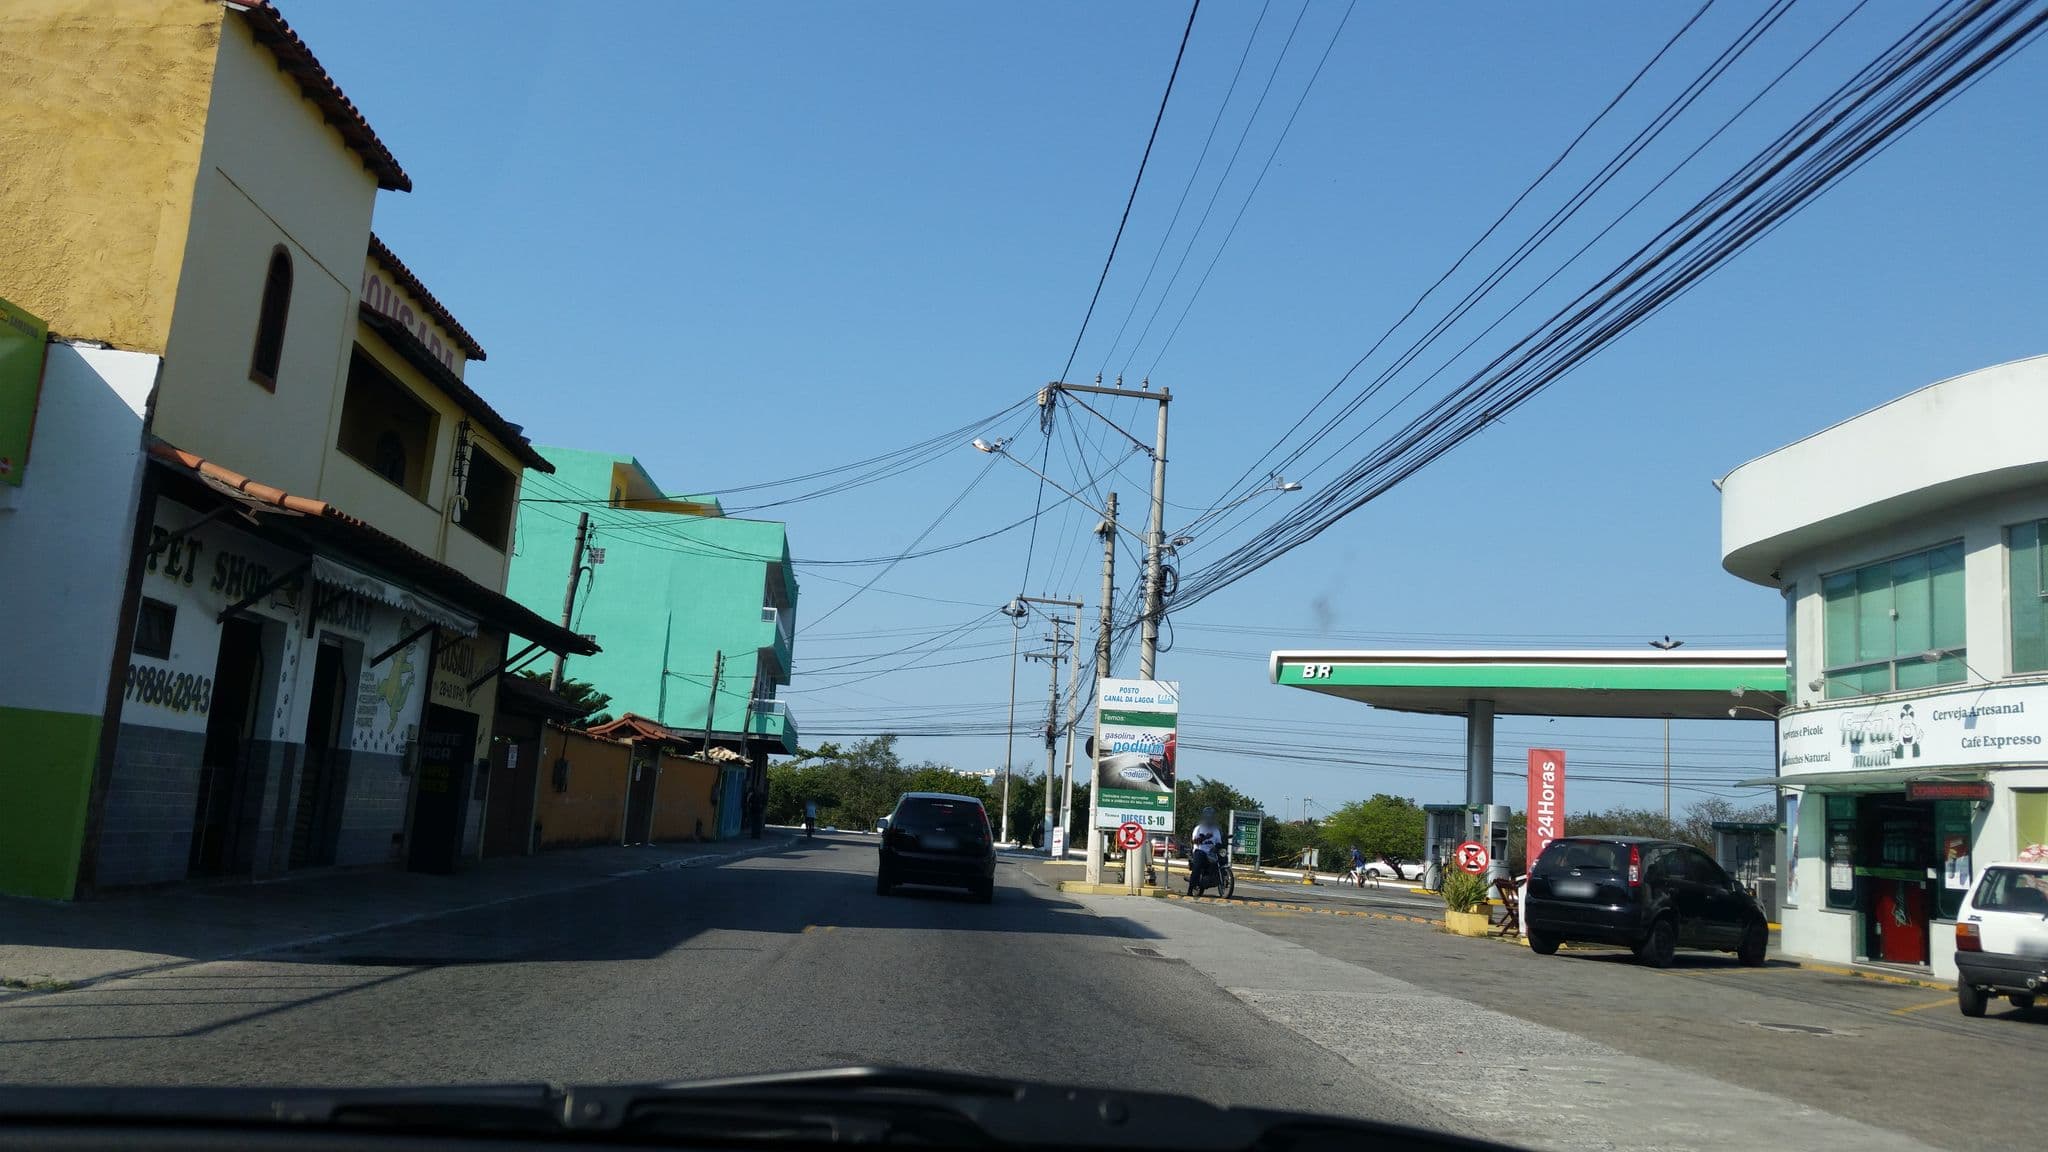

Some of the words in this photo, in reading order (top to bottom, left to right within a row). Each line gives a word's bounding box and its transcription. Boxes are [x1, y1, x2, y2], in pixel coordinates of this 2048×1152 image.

[361, 271, 455, 372] OUSADA
[1303, 664, 1333, 679] BR
[1119, 686, 1139, 694] POSTO
[1103, 695, 1124, 703] CANAL
[1134, 696, 1155, 704] LAGOA
[1932, 708, 1967, 723] Cerveja
[1968, 702, 2024, 719] Artesanal
[1104, 731, 1136, 742] gasolina
[1983, 735, 2042, 749] Expresso
[1112, 739, 1165, 755] podium
[1120, 813, 1147, 825] DIESEL
[1147, 815, 1165, 826] S-10
